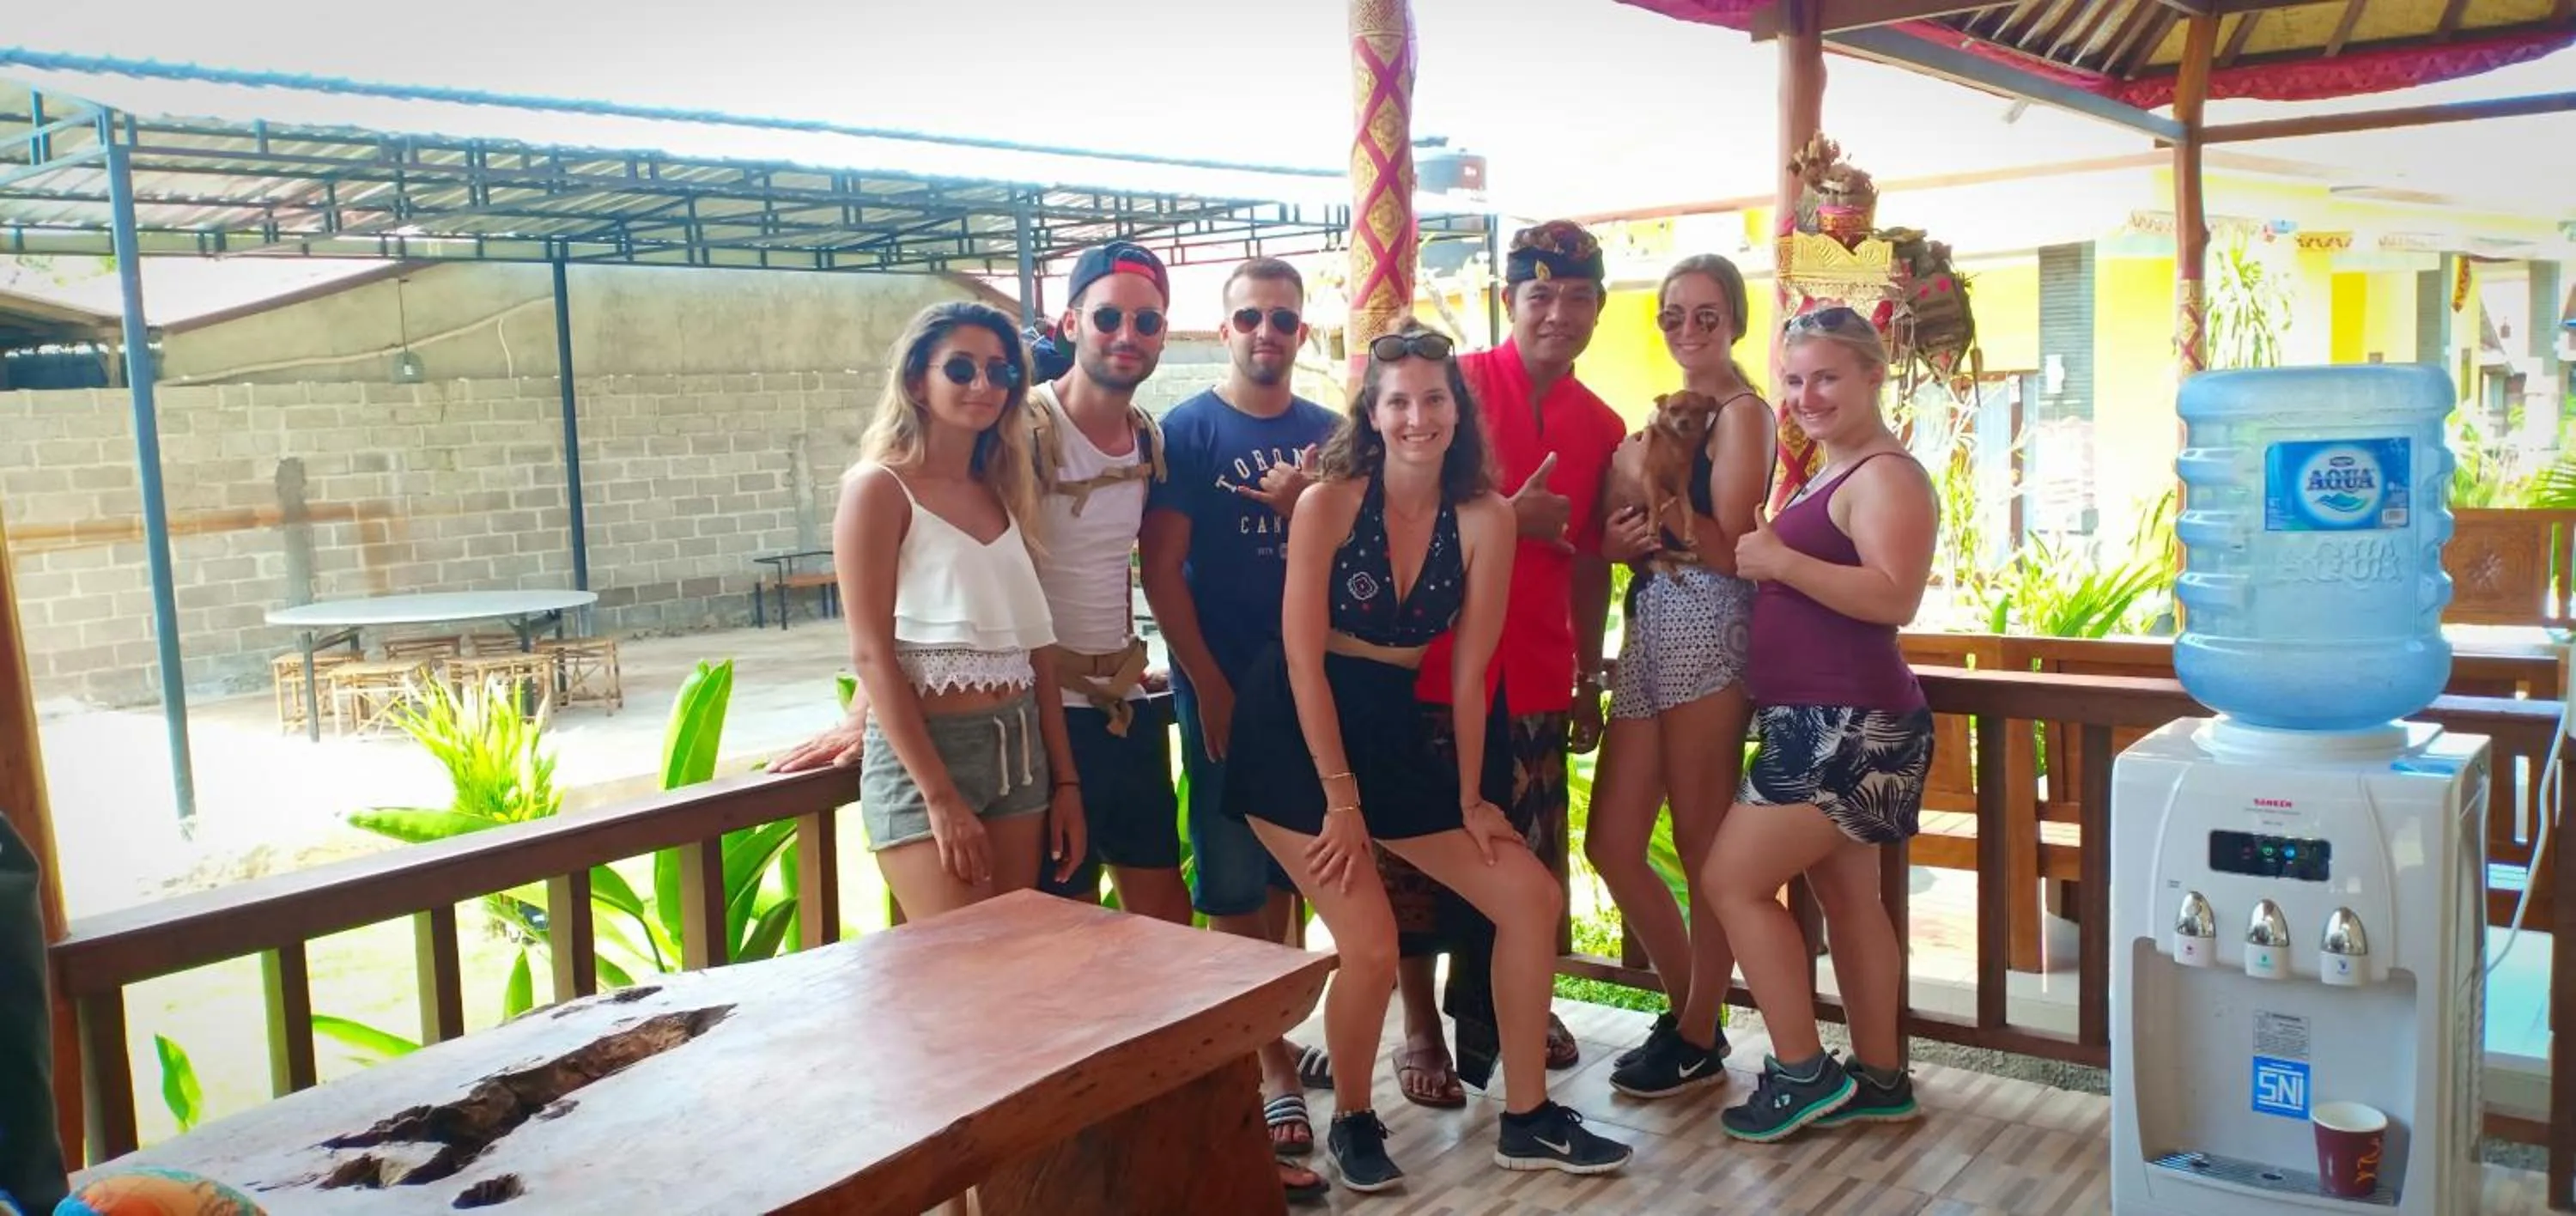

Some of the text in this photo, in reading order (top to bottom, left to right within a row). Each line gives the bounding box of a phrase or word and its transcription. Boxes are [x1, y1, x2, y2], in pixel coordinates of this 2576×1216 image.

[1215, 447, 1305, 493] TORON
[2306, 468, 2376, 493] AQUA
[1240, 515, 1282, 533] CAN
[2277, 538, 2403, 589] AQUA
[2258, 1072, 2304, 1106] SNI
